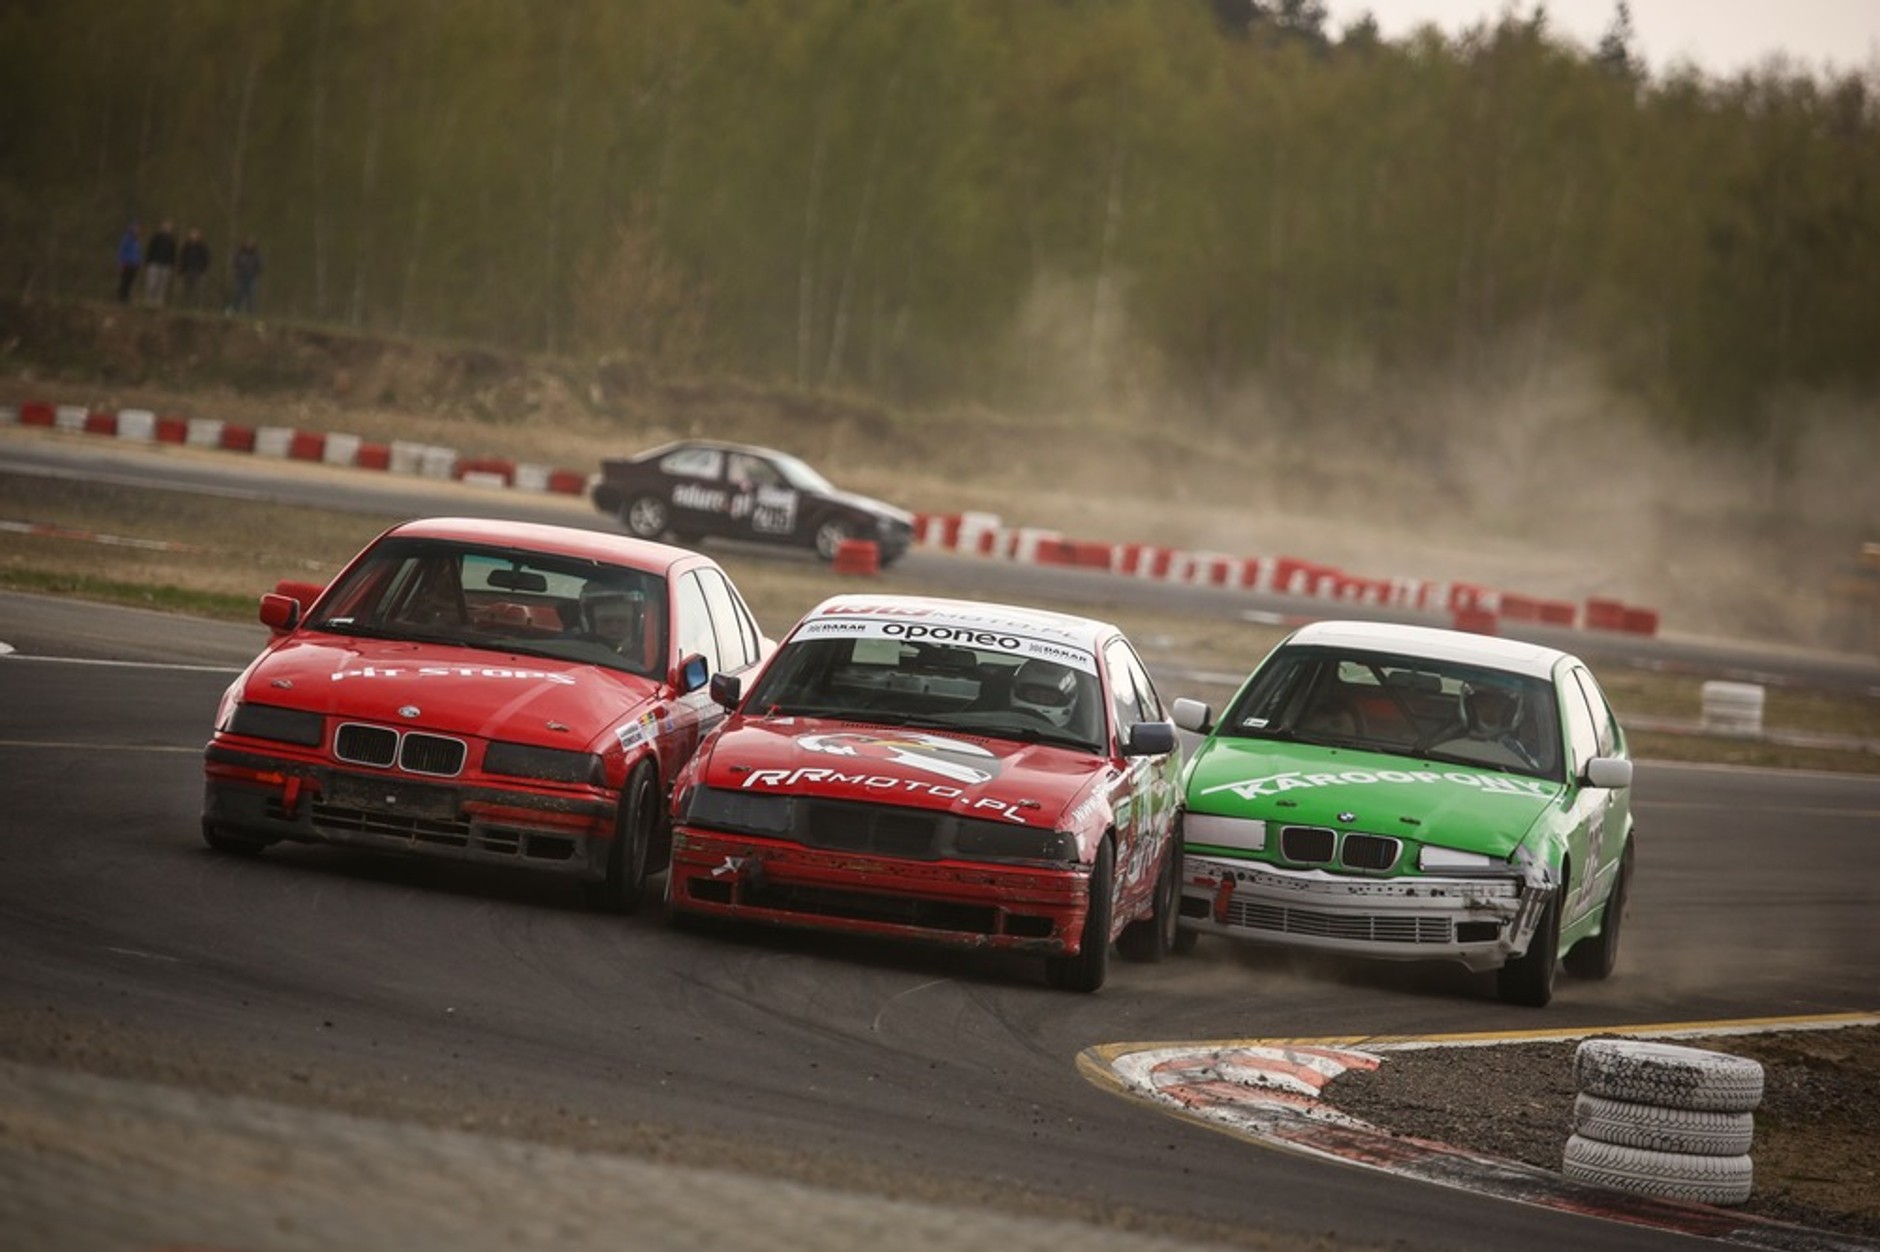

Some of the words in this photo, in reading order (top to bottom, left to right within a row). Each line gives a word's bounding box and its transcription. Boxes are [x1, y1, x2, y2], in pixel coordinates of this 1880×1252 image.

[823, 624, 866, 633] DAKAR
[882, 623, 1020, 650] oponeo
[1043, 646, 1087, 663] DAKAR
[742, 768, 1026, 822] RRMOTO.PL
